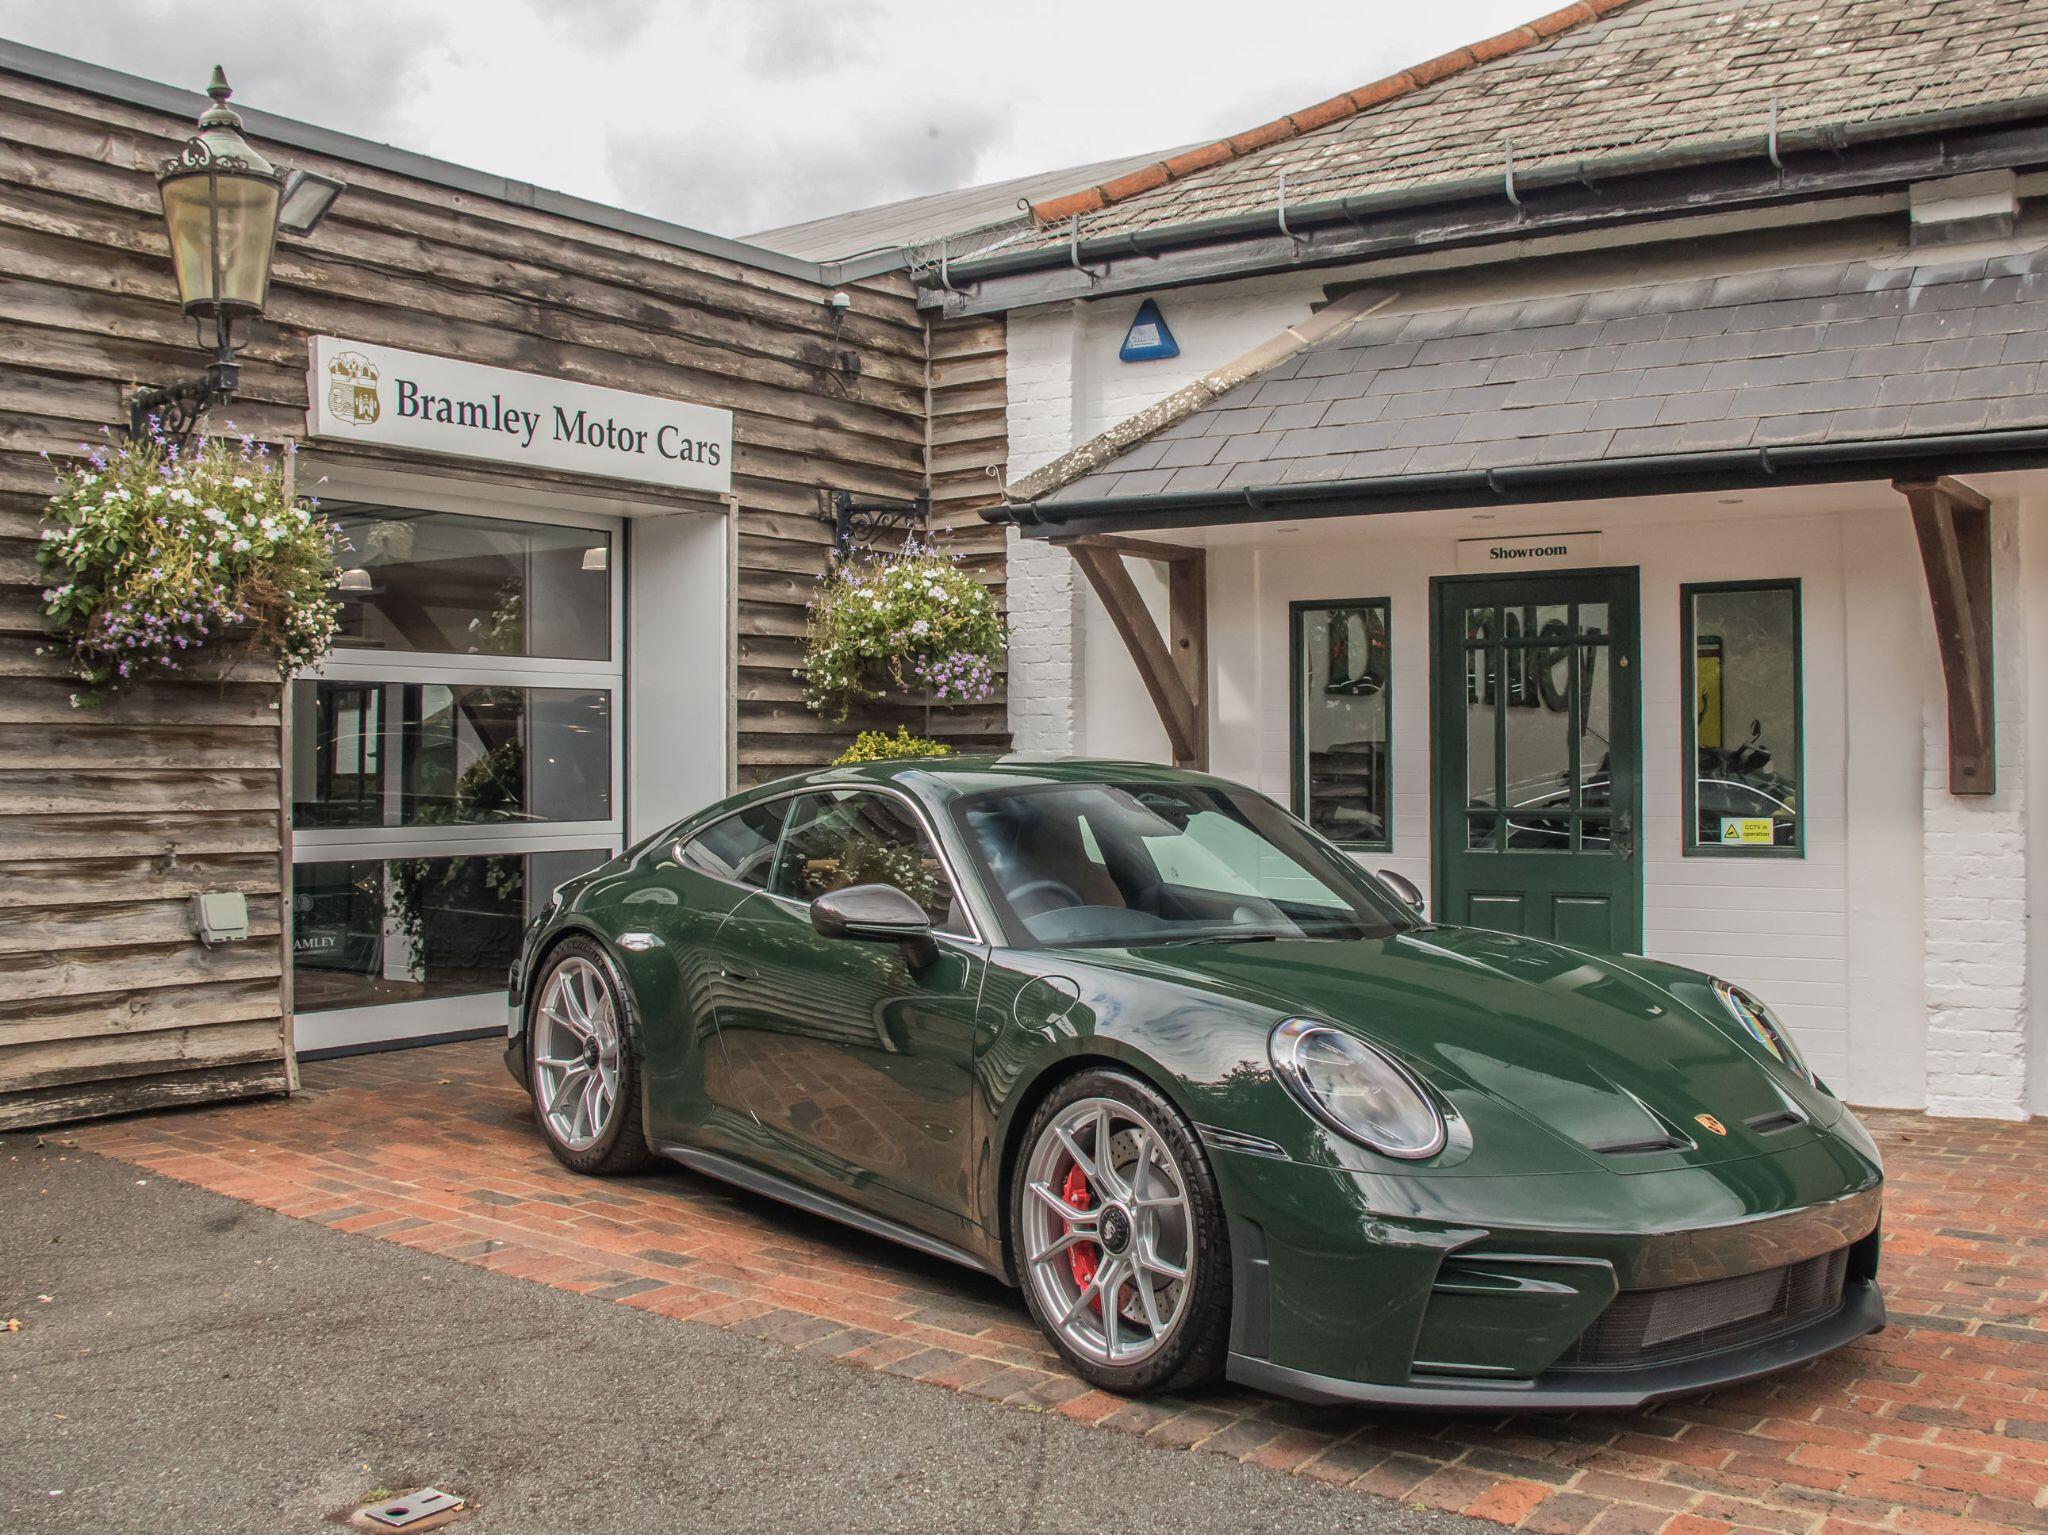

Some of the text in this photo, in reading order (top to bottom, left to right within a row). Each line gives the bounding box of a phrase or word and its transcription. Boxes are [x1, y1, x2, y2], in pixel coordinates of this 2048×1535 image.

[394, 378, 721, 466] Bramley Motor Cars
[1489, 545, 1568, 560] Showroom
